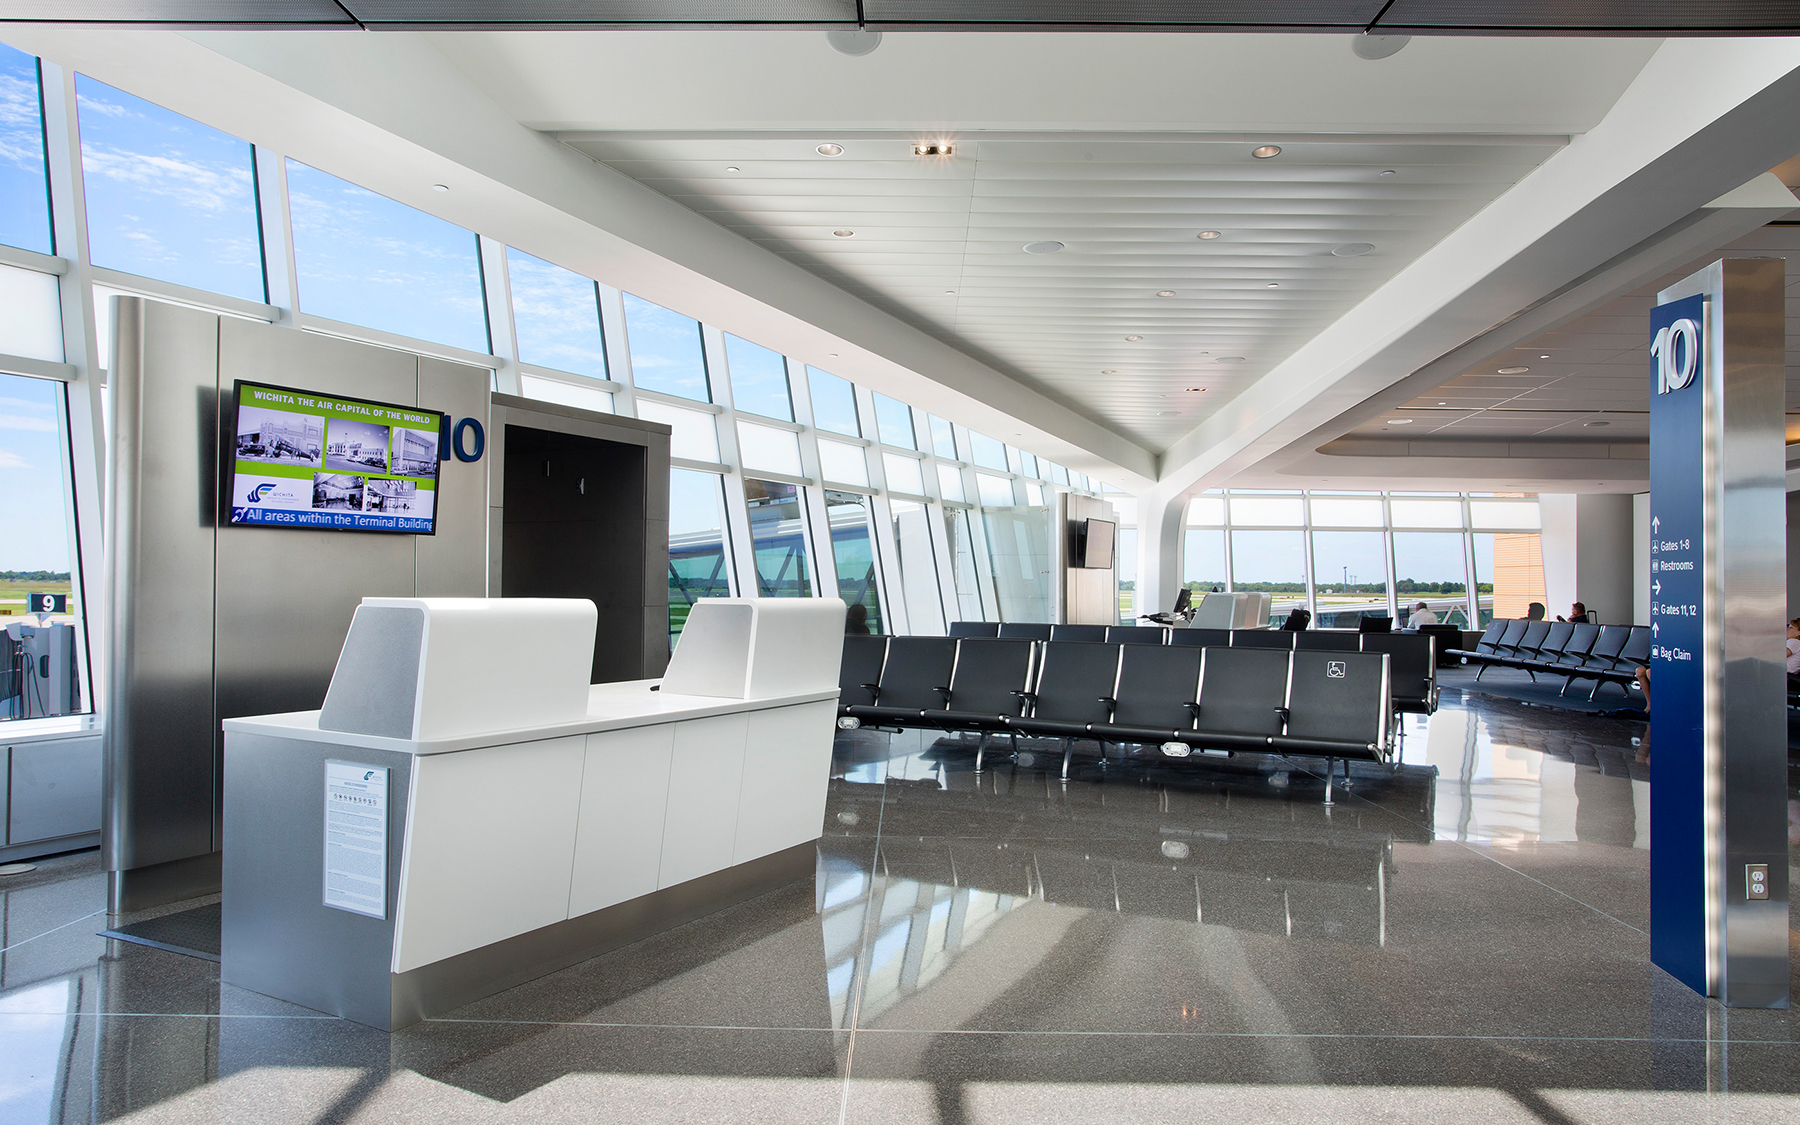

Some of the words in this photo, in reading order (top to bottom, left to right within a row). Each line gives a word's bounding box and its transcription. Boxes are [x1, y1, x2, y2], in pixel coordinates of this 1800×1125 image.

[1650, 318, 1697, 395] 10
[254, 390, 294, 404] WICHITA
[297, 397, 315, 407] THE
[317, 400, 333, 410] AIR
[335, 404, 371, 416] CAPITAL
[372, 408, 384, 417] OF
[386, 411, 402, 420] THE
[403, 413, 430, 424] WORLD
[246, 509, 262, 520] All
[265, 512, 295, 522] areas
[298, 512, 331, 524] within
[334, 514, 351, 525] the
[353, 515, 396, 528] Terminal
[399, 518, 432, 532] Building
[1660, 541, 1679, 551] Gates
[1680, 539, 1690, 550] 1-8
[1660, 560, 1694, 571] Restrooms
[42, 594, 56, 612] 9
[1660, 604, 1680, 615] Gates
[1660, 646, 1672, 661] Bag
[1673, 647, 1692, 661] Claim
